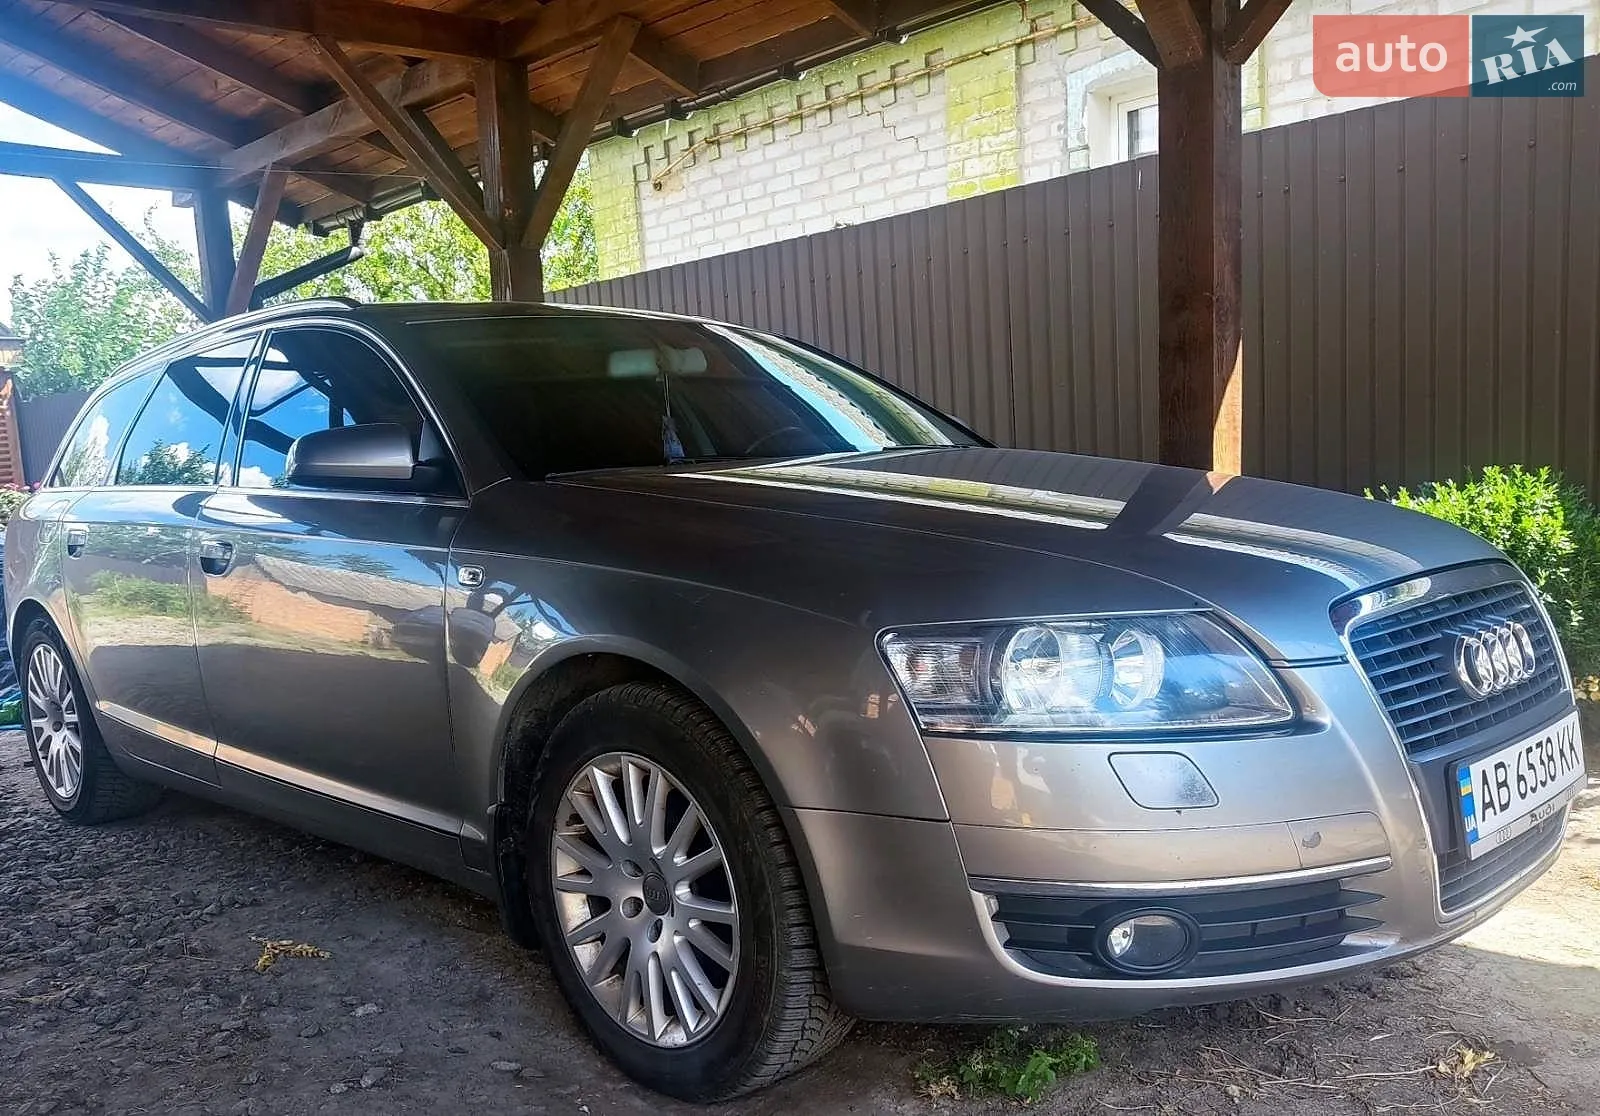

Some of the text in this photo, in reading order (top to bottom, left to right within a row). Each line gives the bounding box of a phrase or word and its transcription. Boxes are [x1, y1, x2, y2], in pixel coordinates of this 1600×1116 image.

[1481, 721, 1580, 822] AB 6538 KK
[1464, 815, 1477, 833] UA
[1529, 804, 1555, 826] Audi
